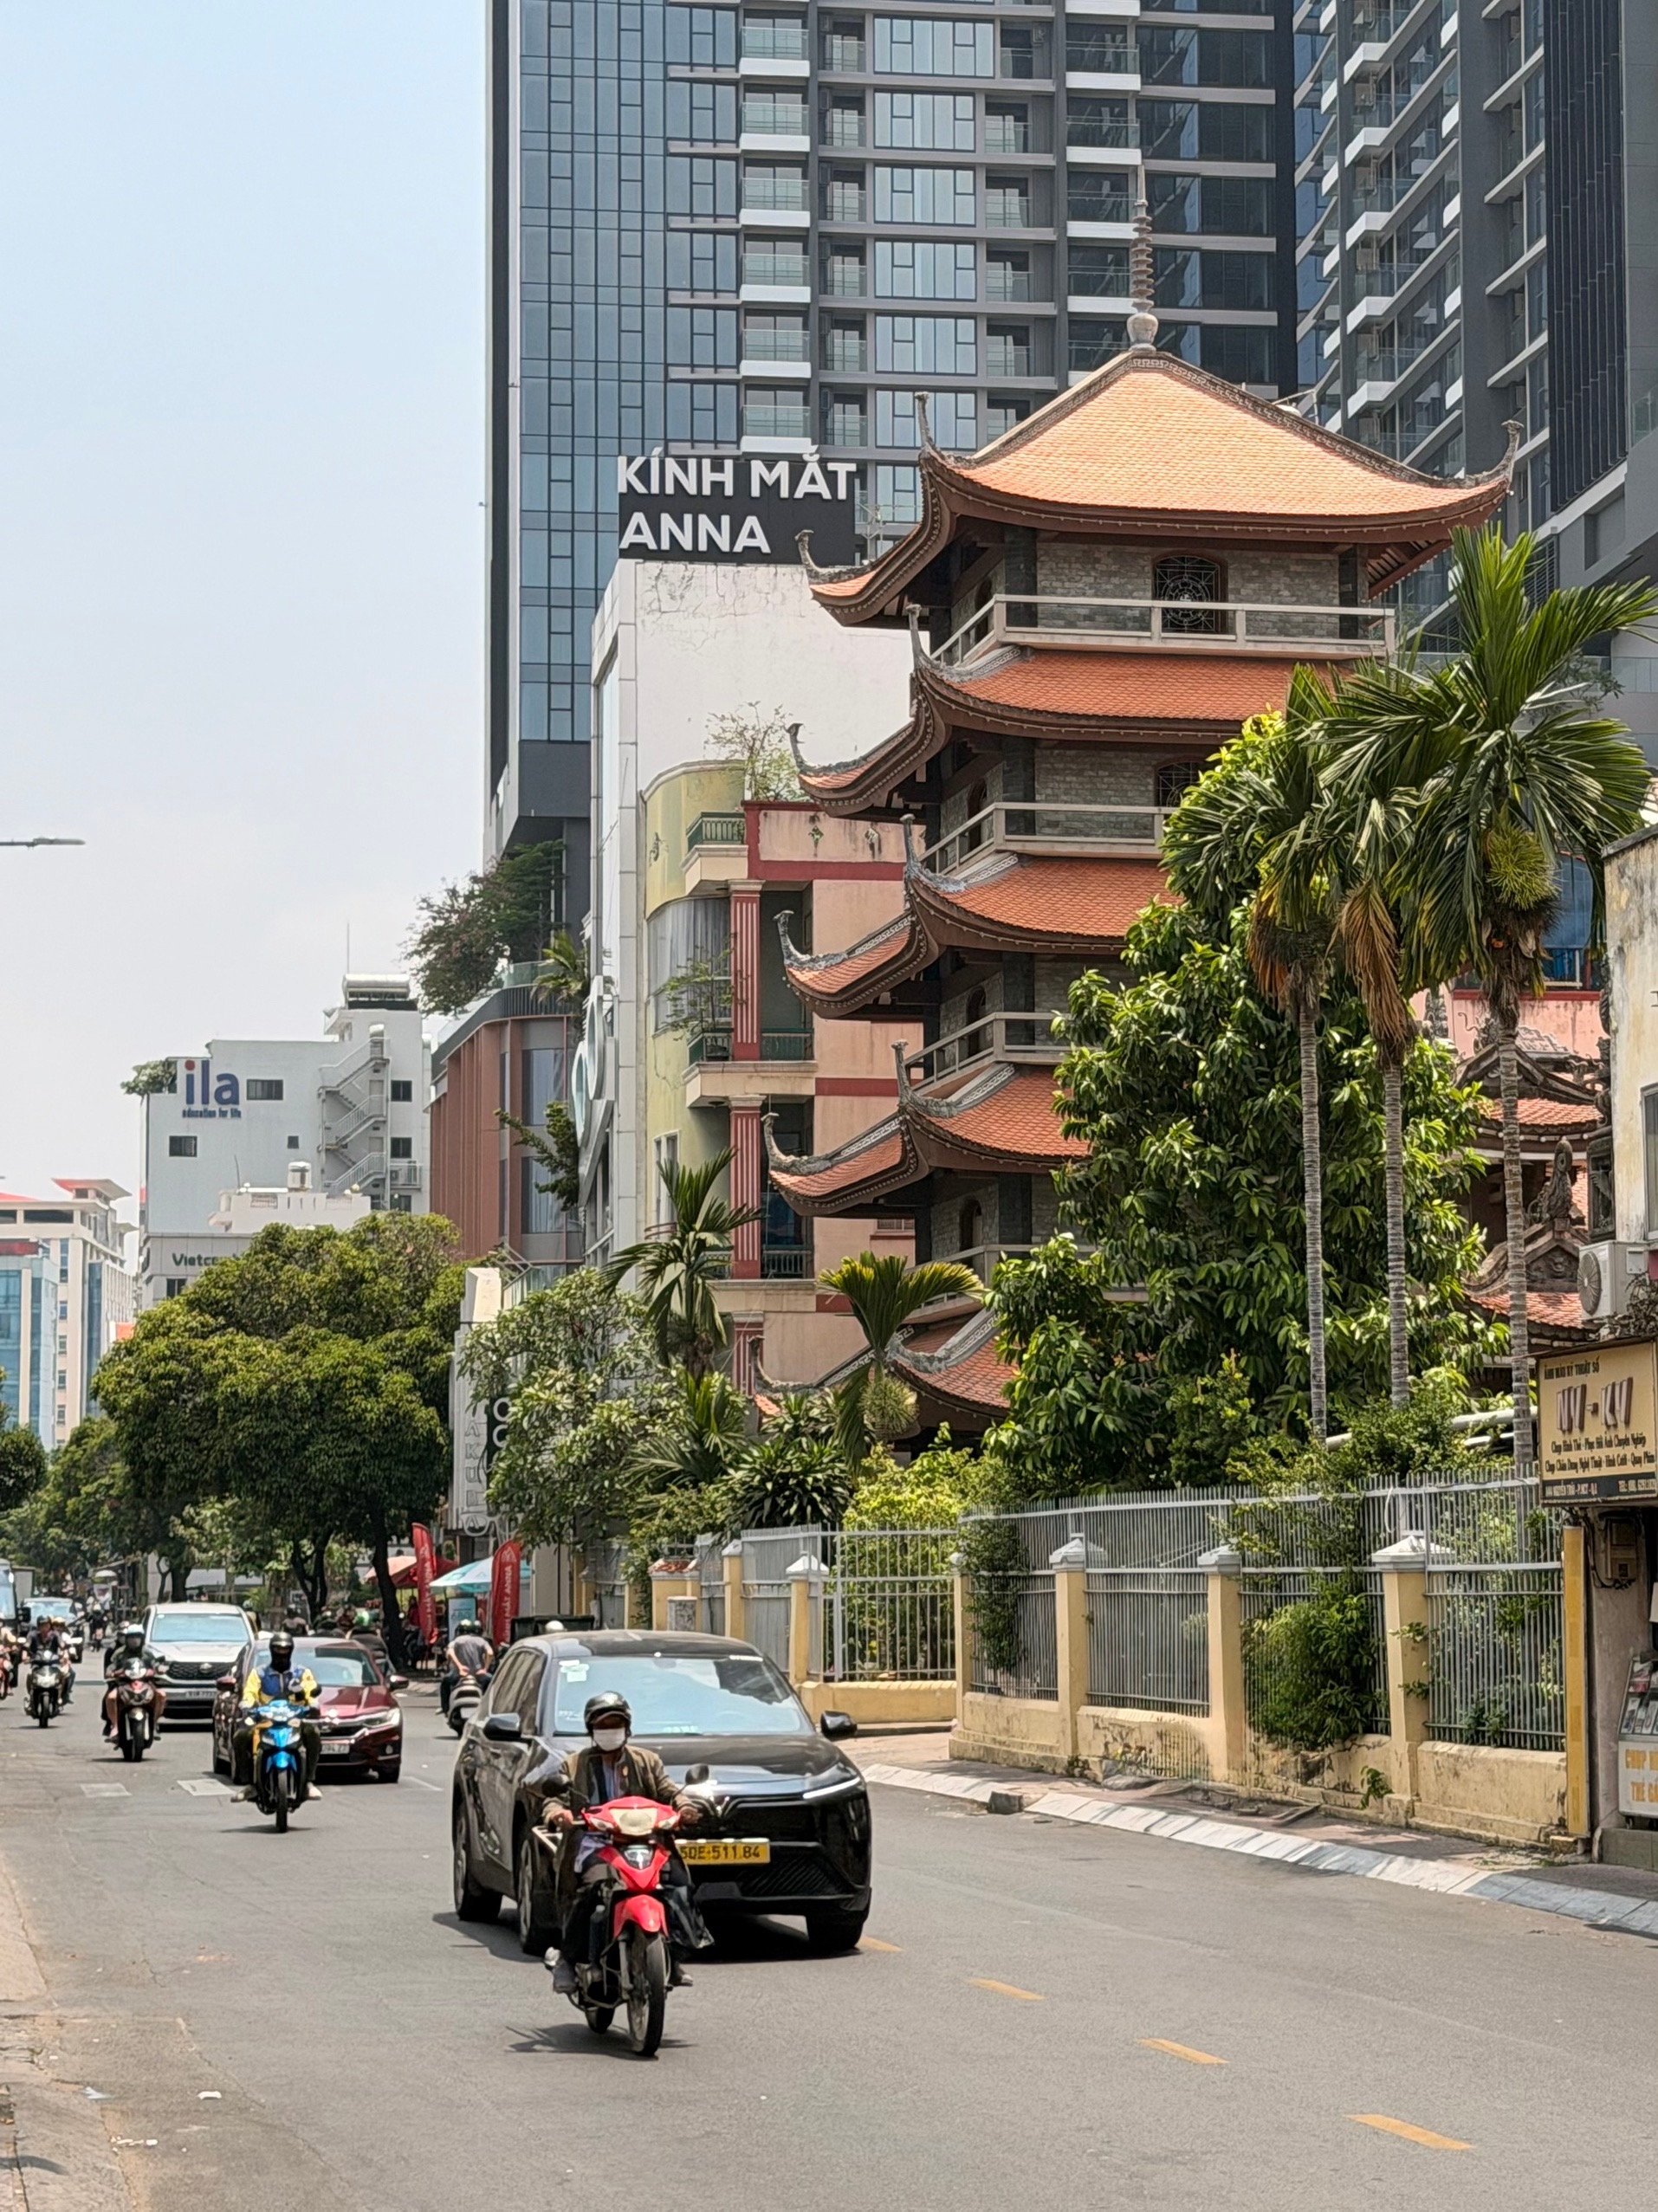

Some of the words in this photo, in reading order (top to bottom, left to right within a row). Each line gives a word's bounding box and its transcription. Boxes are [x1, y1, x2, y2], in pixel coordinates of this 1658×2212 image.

[618, 446, 735, 497] KÍNH
[750, 444, 858, 501] MẮT
[619, 511, 771, 554] ANNA
[185, 1059, 240, 1107] ila
